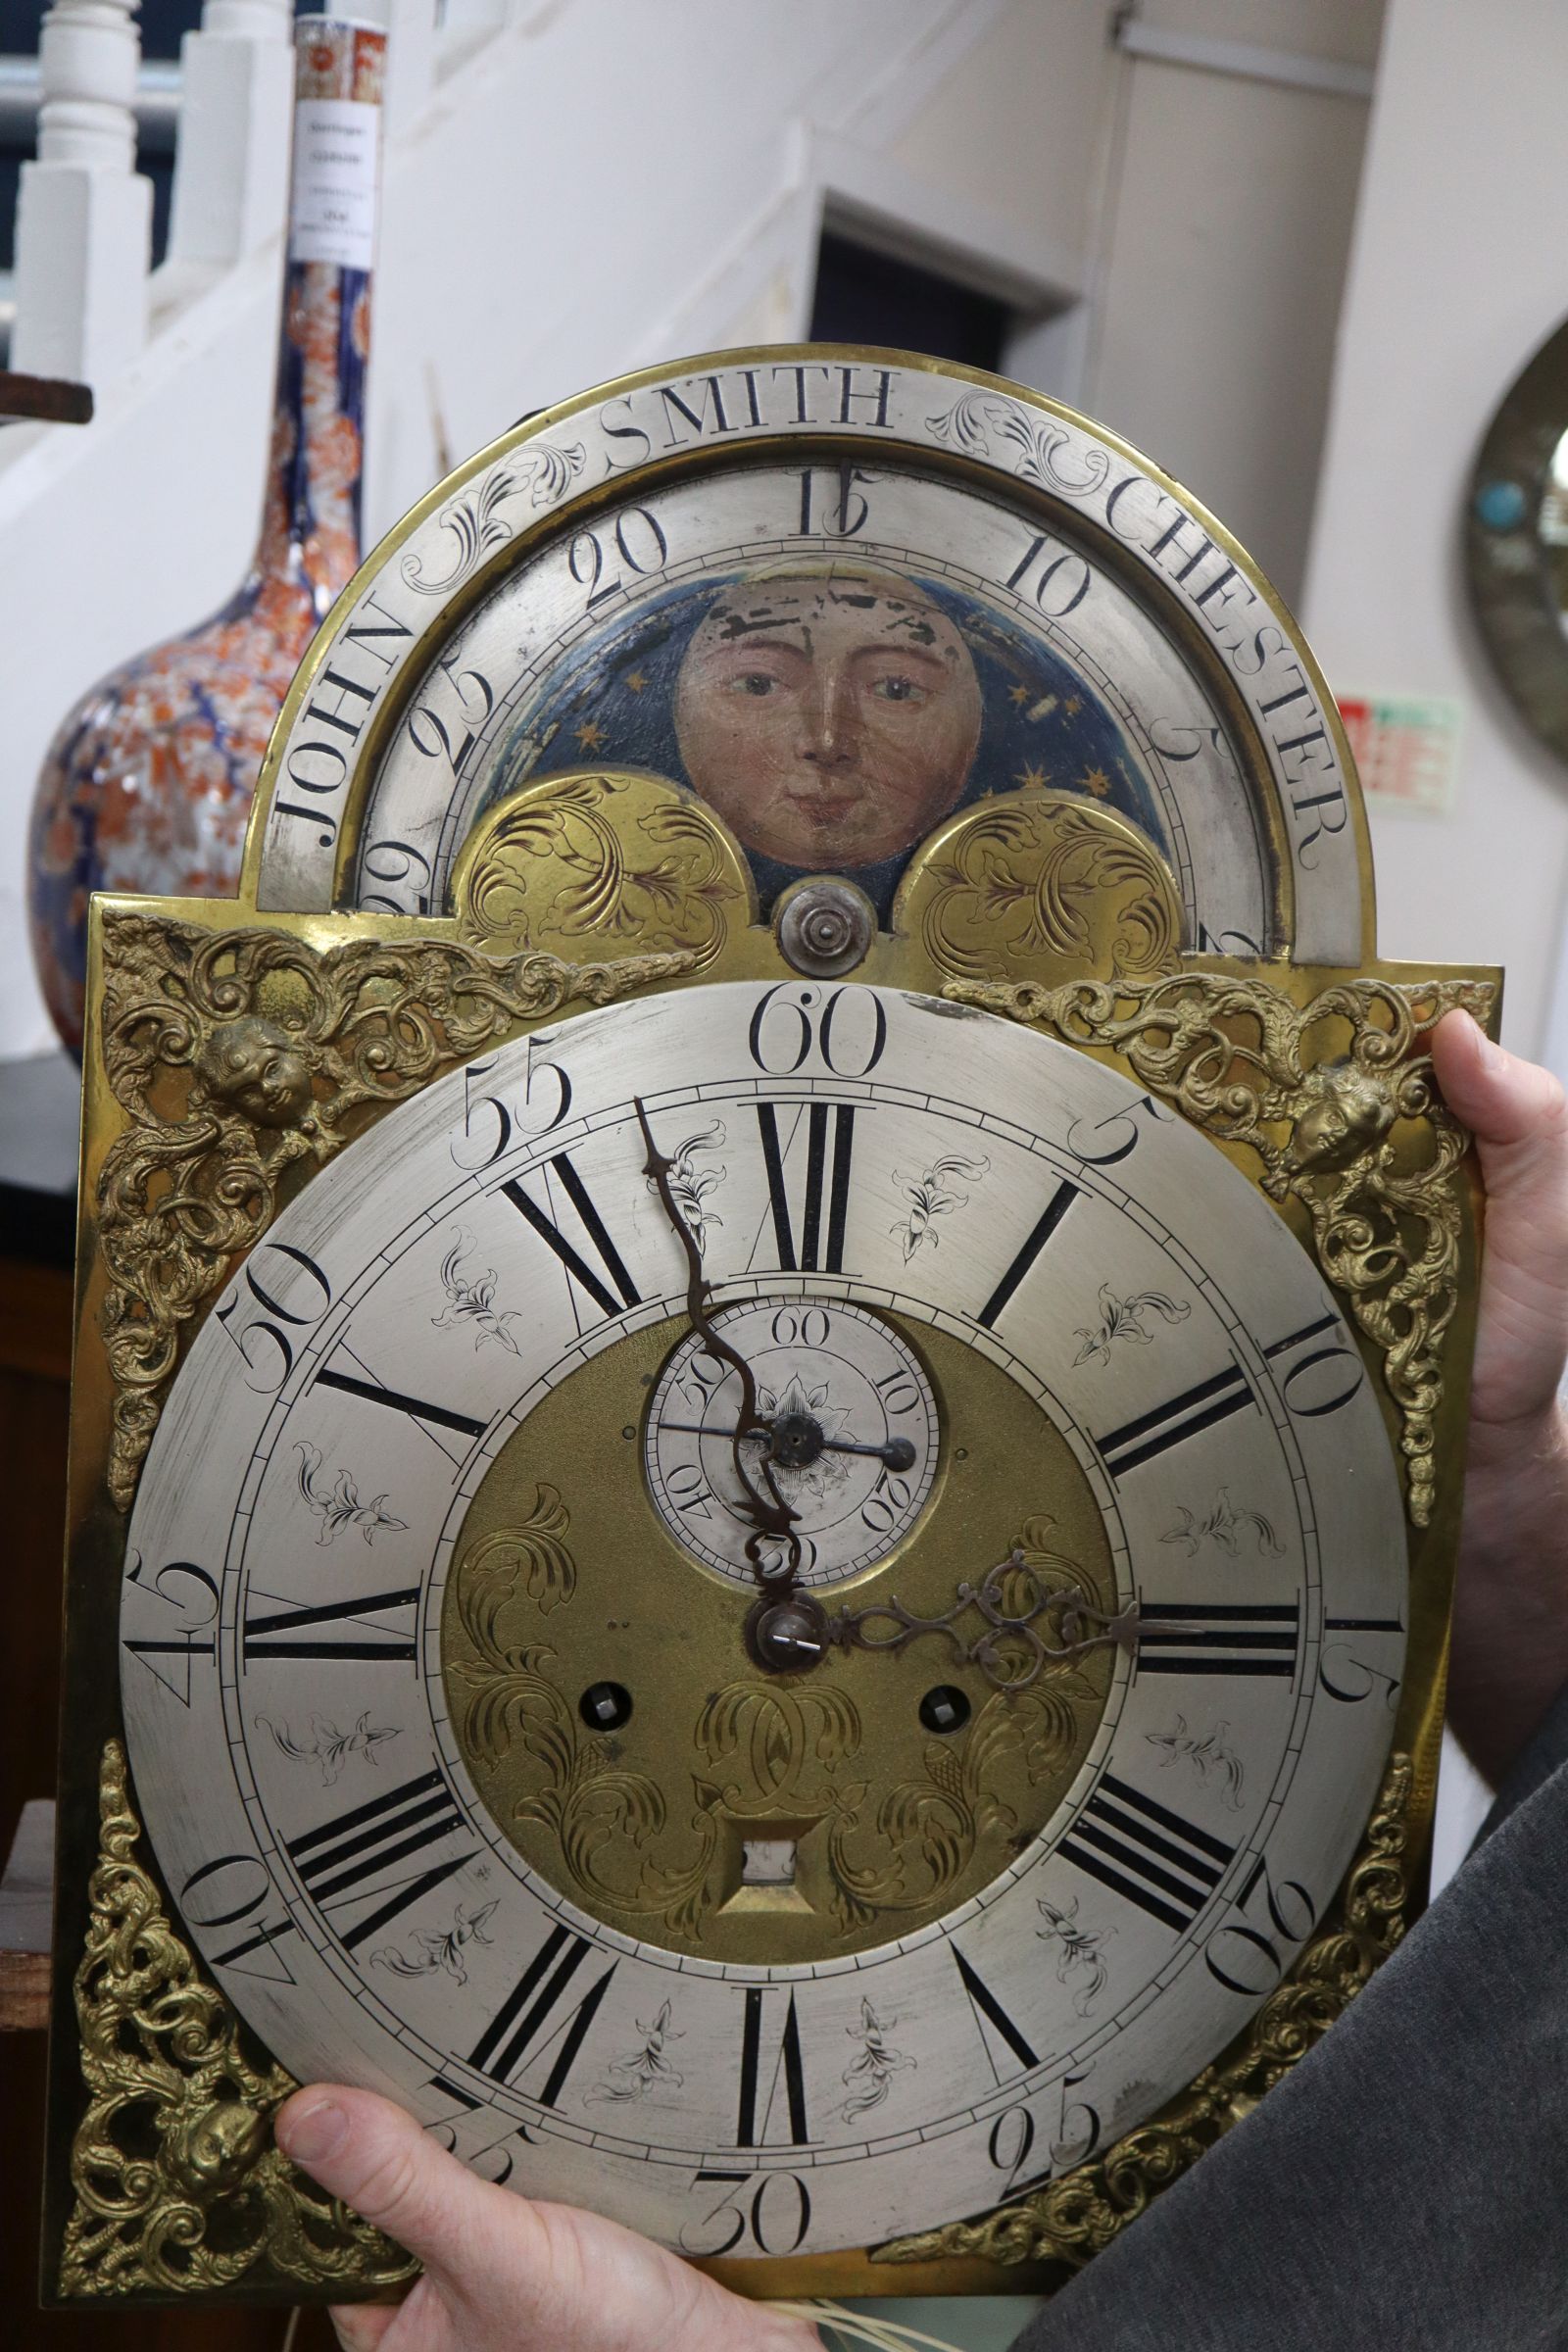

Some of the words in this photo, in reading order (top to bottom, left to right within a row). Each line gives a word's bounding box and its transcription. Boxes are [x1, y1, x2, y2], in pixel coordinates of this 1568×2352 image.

[568, 507, 669, 610] 20
[785, 468, 884, 538] 15
[272, 590, 416, 849] JOHN
[599, 366, 902, 475] SMITH
[1103, 476, 1351, 871] CHESTER
[997, 524, 1093, 618] 10
[409, 647, 495, 777] 25
[1149, 716, 1231, 762] 5
[748, 981, 888, 1078] 60
[449, 1032, 573, 1171] 55
[1066, 1095, 1176, 1166] 5
[485, 1142, 662, 1348] XI
[728, 1101, 877, 1278] XII
[215, 1243, 332, 1395] 50
[675, 1351, 725, 1417] 50
[771, 1305, 831, 1347] 60
[1255, 1291, 1364, 1417] 10
[305, 1325, 501, 1486] X
[871, 1356, 920, 1415] 10
[1086, 1348, 1263, 1494] II
[665, 1464, 718, 1521] 40
[860, 1471, 911, 1534] 20
[121, 1547, 221, 1709] 45
[242, 1569, 424, 1680] IX
[1133, 1586, 1300, 1694] III
[1320, 1602, 1405, 1712] 15
[278, 1752, 486, 1966] VIII
[1041, 1756, 1246, 1949] IIII
[179, 1854, 305, 1986] 40
[1204, 1854, 1316, 1996] 20
[450, 1912, 620, 2116] VII
[717, 1984, 825, 2148] VI
[948, 1936, 1056, 2095] V
[988, 2061, 1101, 2204] 25
[679, 2172, 811, 2255] 30
